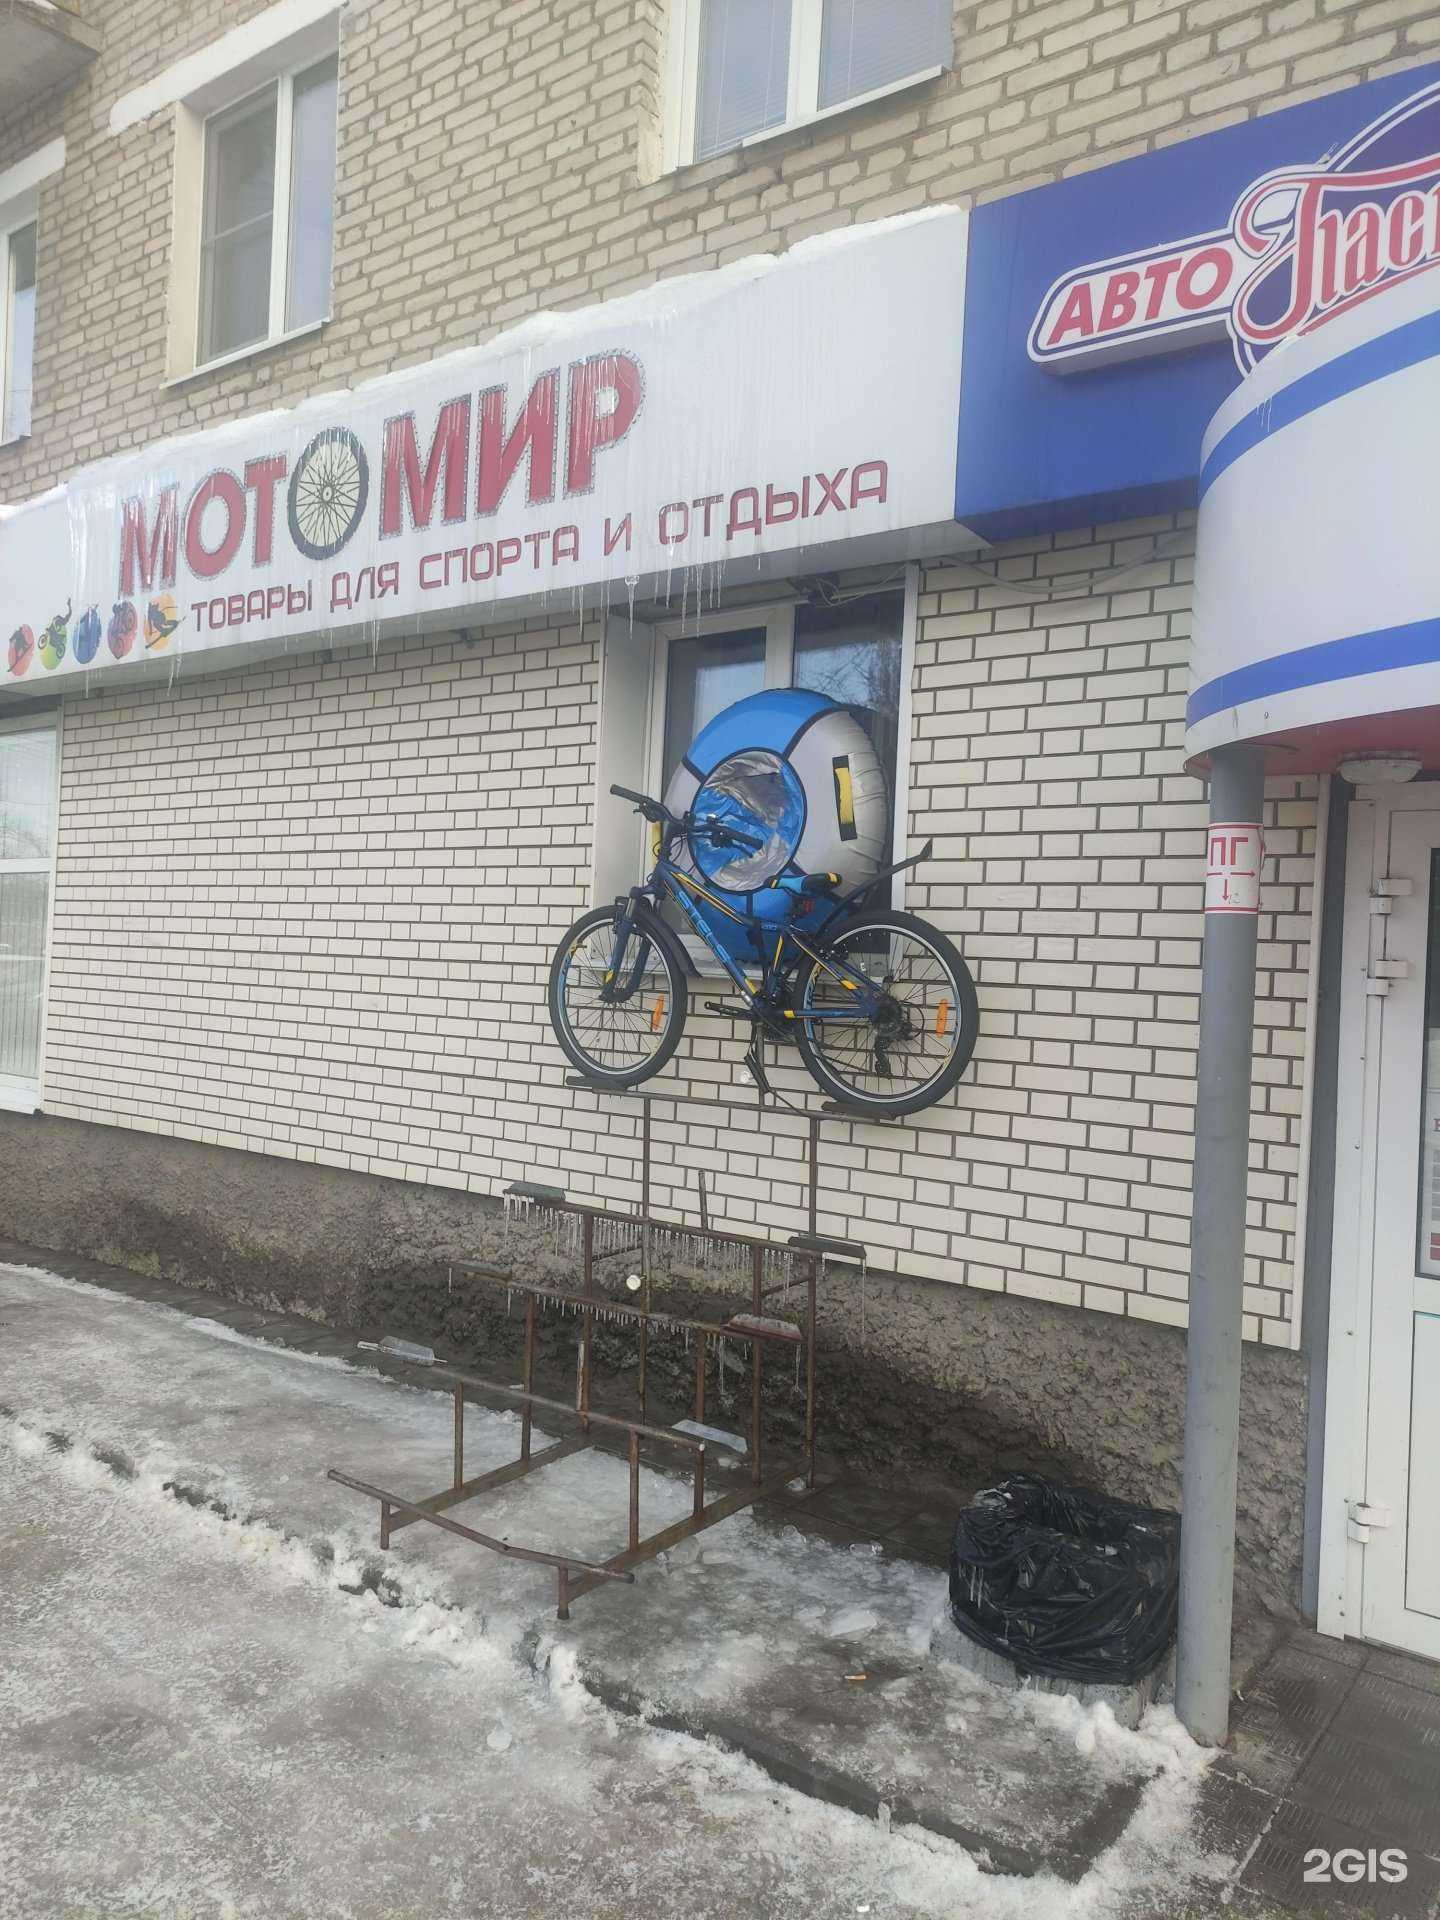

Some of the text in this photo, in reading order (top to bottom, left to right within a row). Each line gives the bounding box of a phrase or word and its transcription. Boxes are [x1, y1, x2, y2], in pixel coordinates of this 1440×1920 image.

[1045, 155, 1440, 347] АВТО Пас
[191, 460, 889, 632] ТОВАРЫ ДЛЯ СПОРТА И ОТДЫХА
[1210, 836, 1249, 867] ПГ
